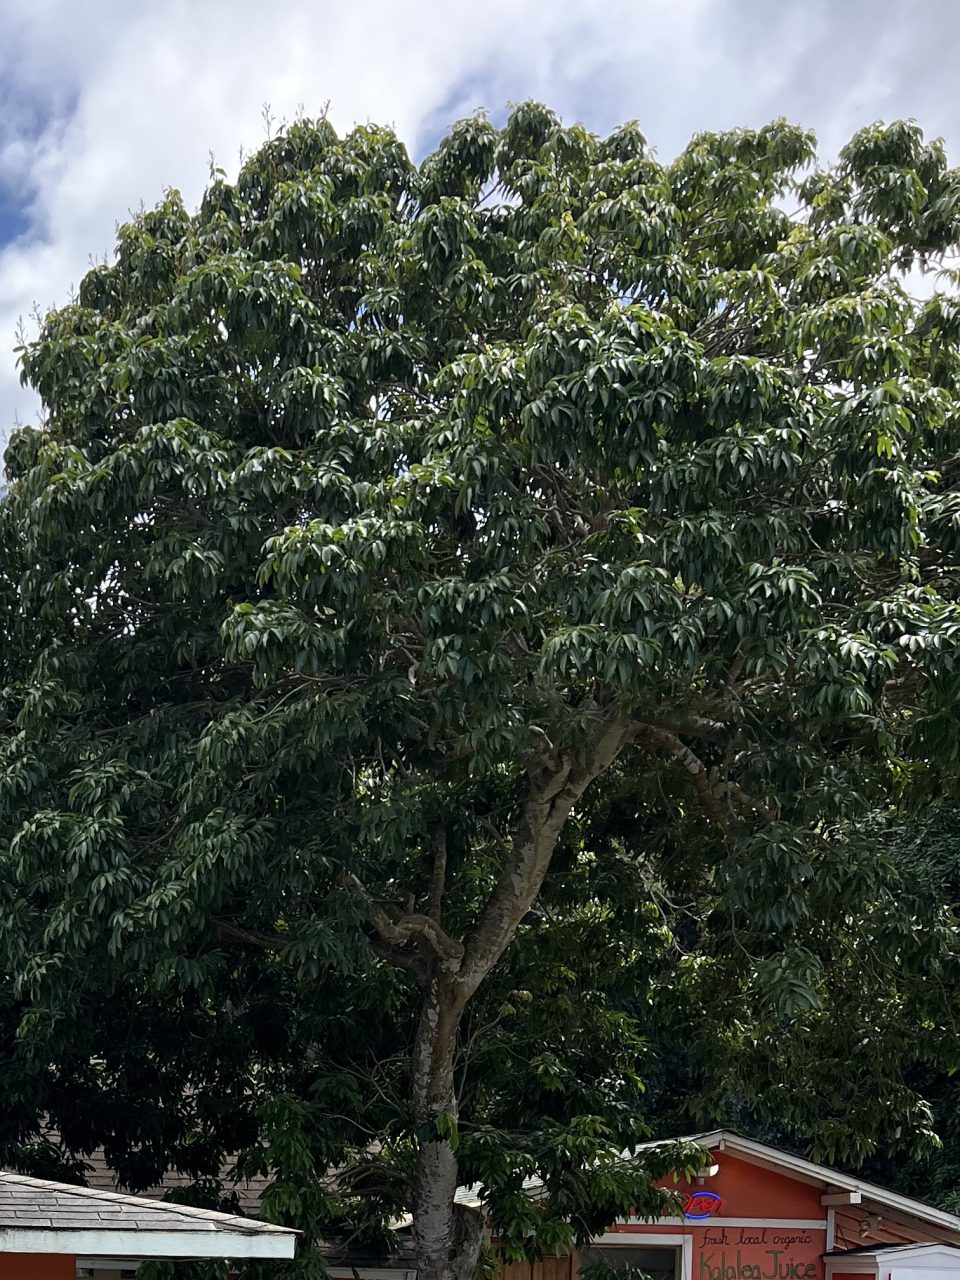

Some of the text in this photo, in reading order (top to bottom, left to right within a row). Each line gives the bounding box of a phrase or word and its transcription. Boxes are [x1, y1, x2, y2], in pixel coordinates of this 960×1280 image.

[699, 1228, 811, 1250] fresh local organic
[699, 1250, 817, 1280] Kalalea Juice
